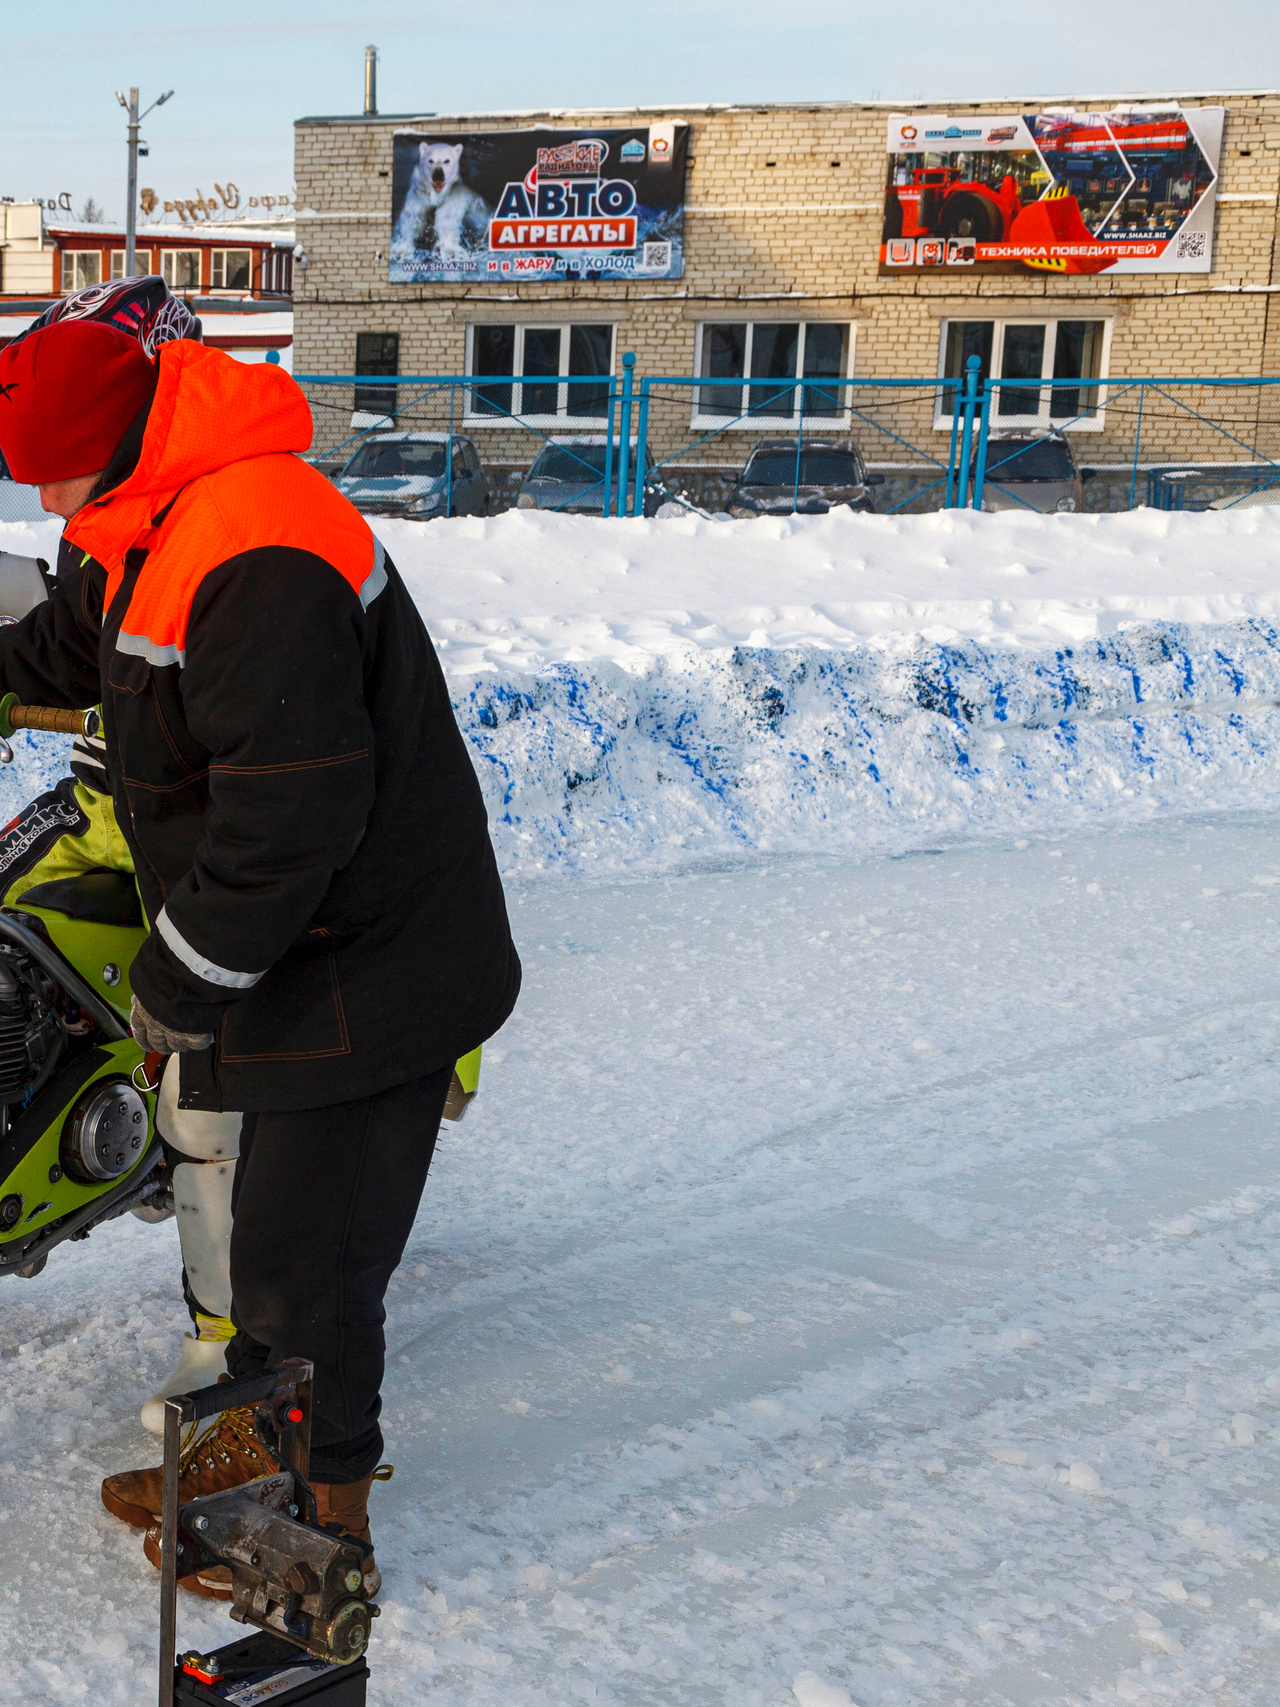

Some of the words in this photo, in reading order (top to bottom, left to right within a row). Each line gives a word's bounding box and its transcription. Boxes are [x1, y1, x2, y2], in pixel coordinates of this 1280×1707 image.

[538, 161, 599, 171] РАДИАТОРЫ
[496, 180, 636, 218] АВТО
[498, 223, 626, 244] АГРЕГАТЫ
[1103, 231, 1167, 239] WWW.SHAAZ.BIZ
[980, 247, 1047, 256] ТЕХНИКА
[1051, 244, 1157, 257] ПОБЕДИТЕЛЕЙ
[515, 257, 554, 270] ЖАРУ
[585, 256, 635, 270] ХОЛОД
